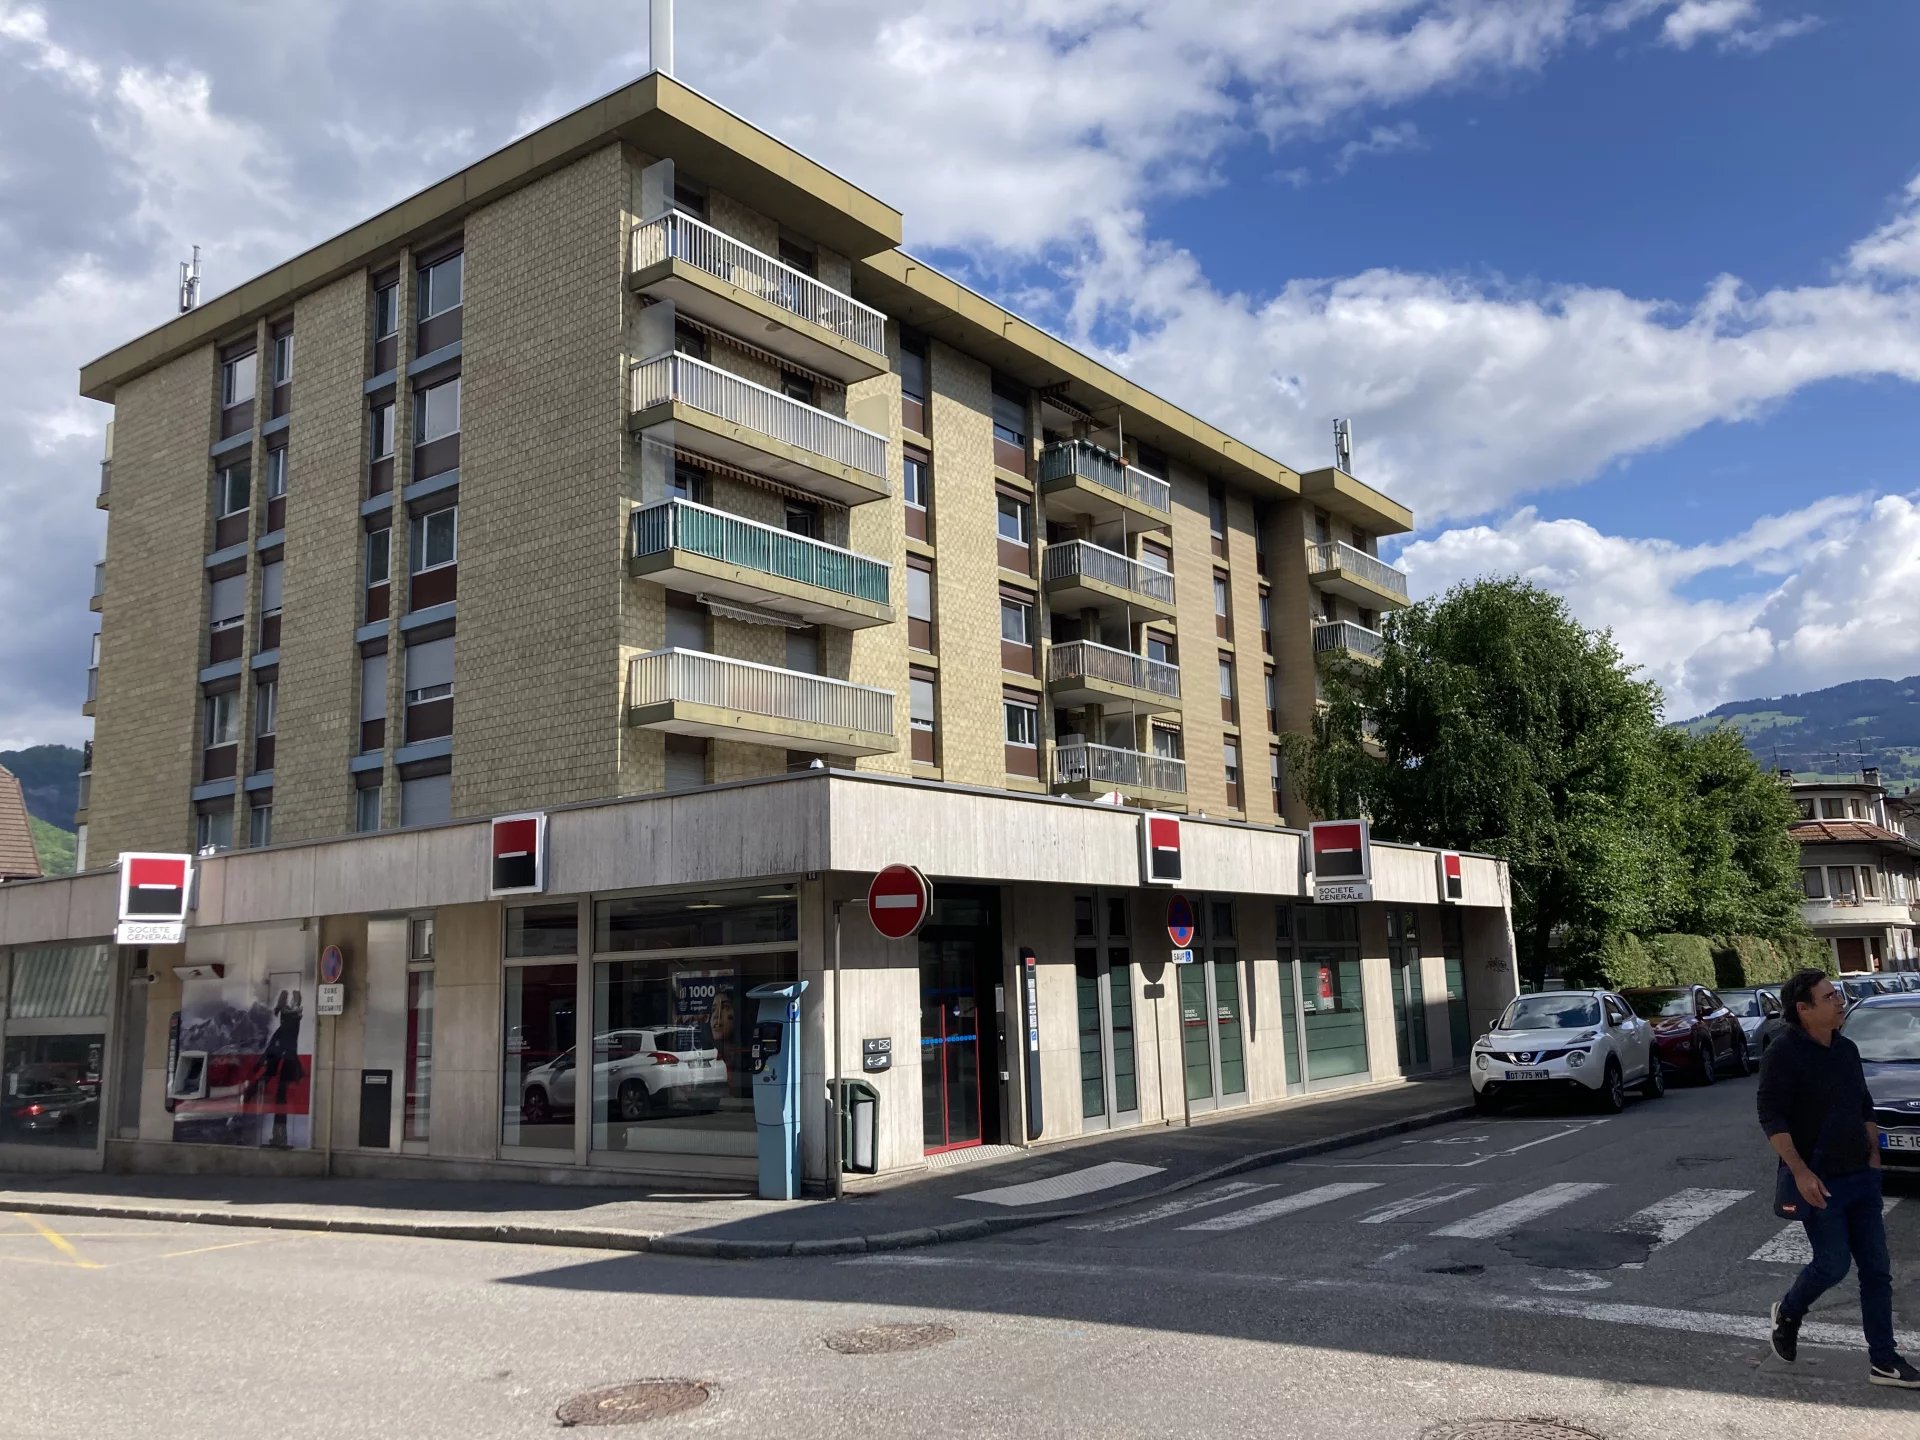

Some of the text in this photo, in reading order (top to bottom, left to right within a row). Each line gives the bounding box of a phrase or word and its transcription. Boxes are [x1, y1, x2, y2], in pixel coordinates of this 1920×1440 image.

[1319, 886, 1354, 895] SOCIETE
[127, 933, 181, 941] GENERALE
[1173, 952, 1185, 961] SAUF
[688, 985, 716, 998] 1000
[789, 1002, 798, 1019] P
